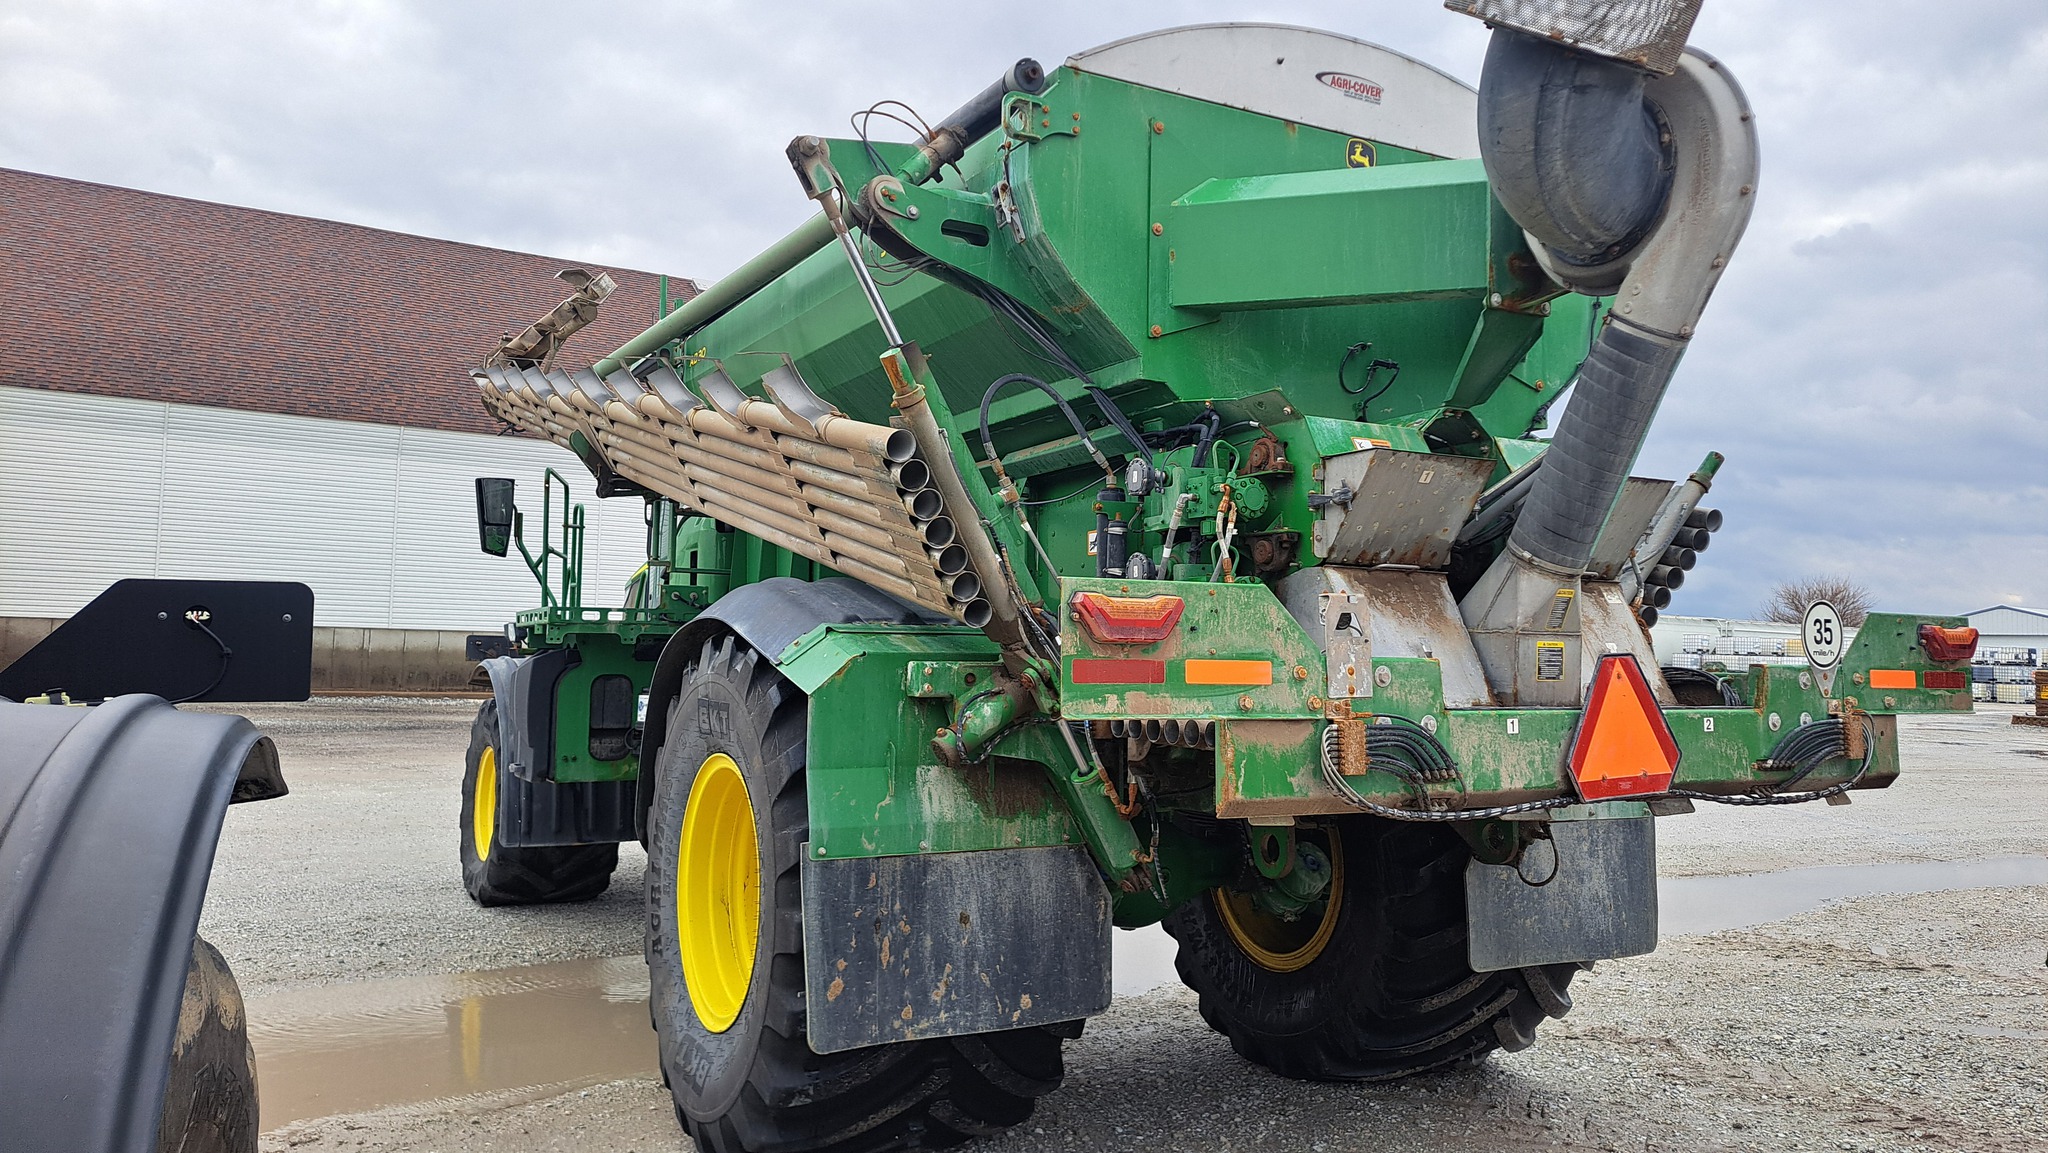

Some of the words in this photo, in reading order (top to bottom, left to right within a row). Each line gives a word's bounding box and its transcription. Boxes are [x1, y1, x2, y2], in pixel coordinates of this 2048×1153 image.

[1330, 75, 1382, 98] AGRI-COVER
[1813, 618, 1833, 645] 35
[1813, 649, 1835, 657] mile/h
[1705, 718, 1712, 730] 2
